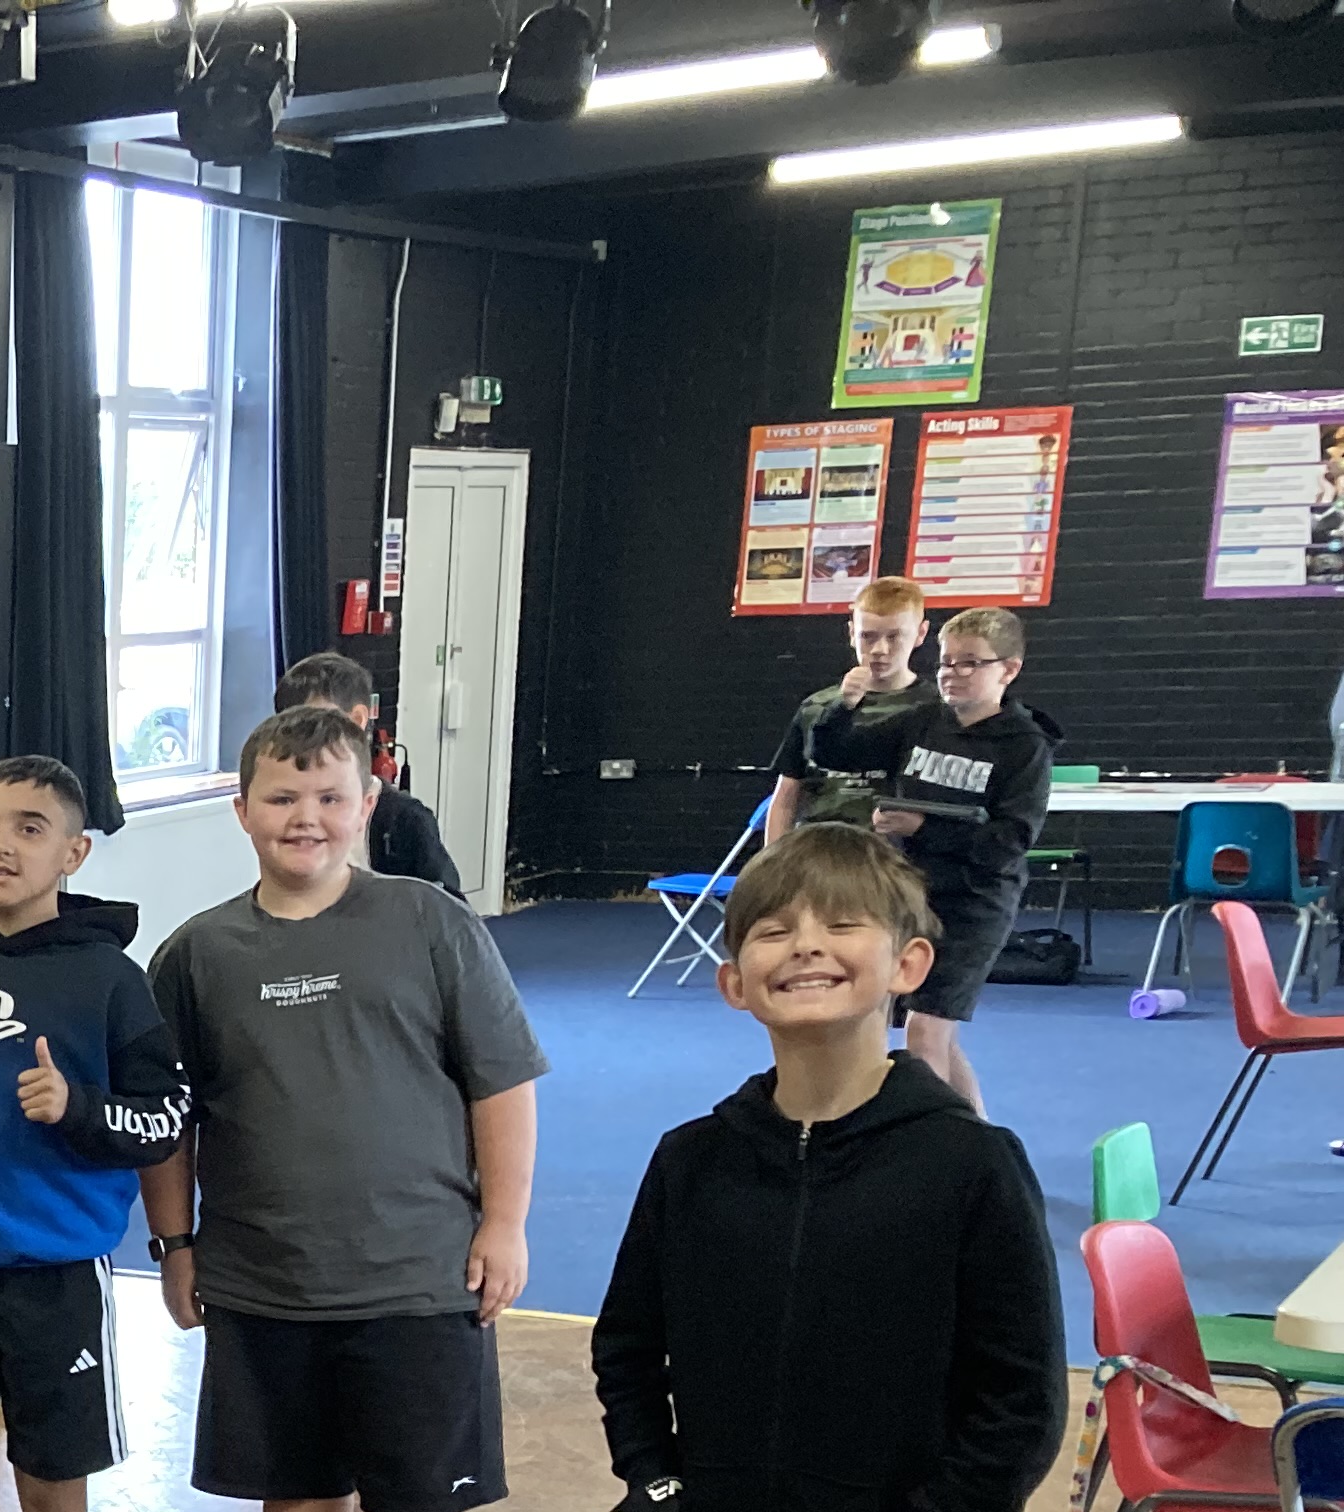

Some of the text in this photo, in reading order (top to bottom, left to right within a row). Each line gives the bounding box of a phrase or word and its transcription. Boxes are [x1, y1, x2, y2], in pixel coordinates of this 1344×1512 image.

[766, 423, 877, 438] TYPES OF STAGING
[927, 418, 966, 435] Acting
[967, 416, 1000, 431] Skills
